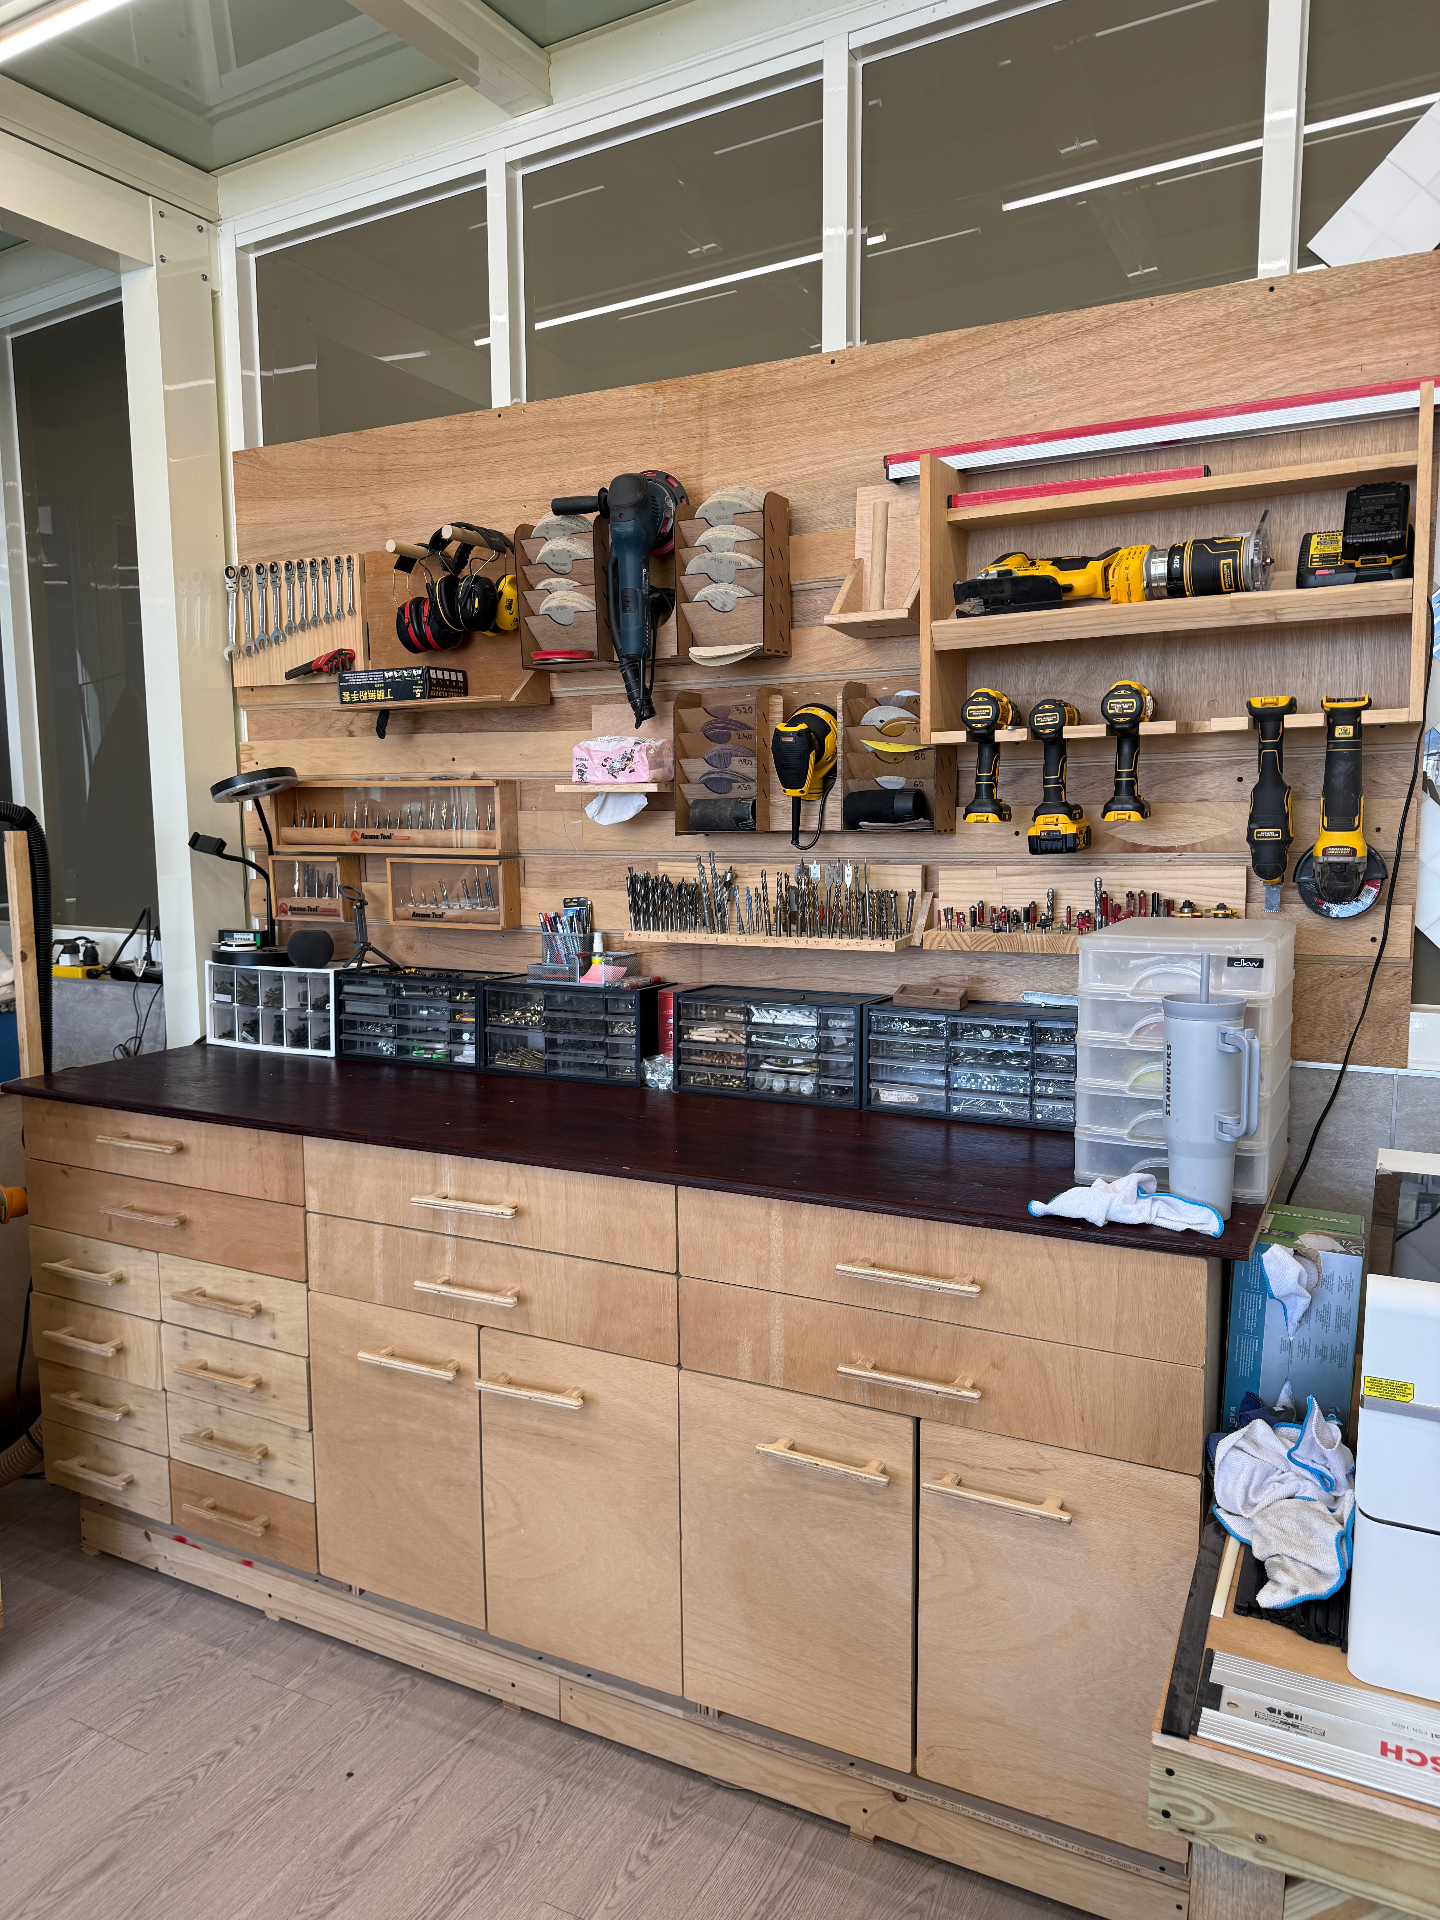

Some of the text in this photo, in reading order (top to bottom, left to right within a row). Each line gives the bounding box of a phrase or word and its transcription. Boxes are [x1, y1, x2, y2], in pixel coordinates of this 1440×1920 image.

[913, 752, 926, 761] 80
[913, 780, 924, 788] 60
[1233, 958, 1260, 967] dkw
